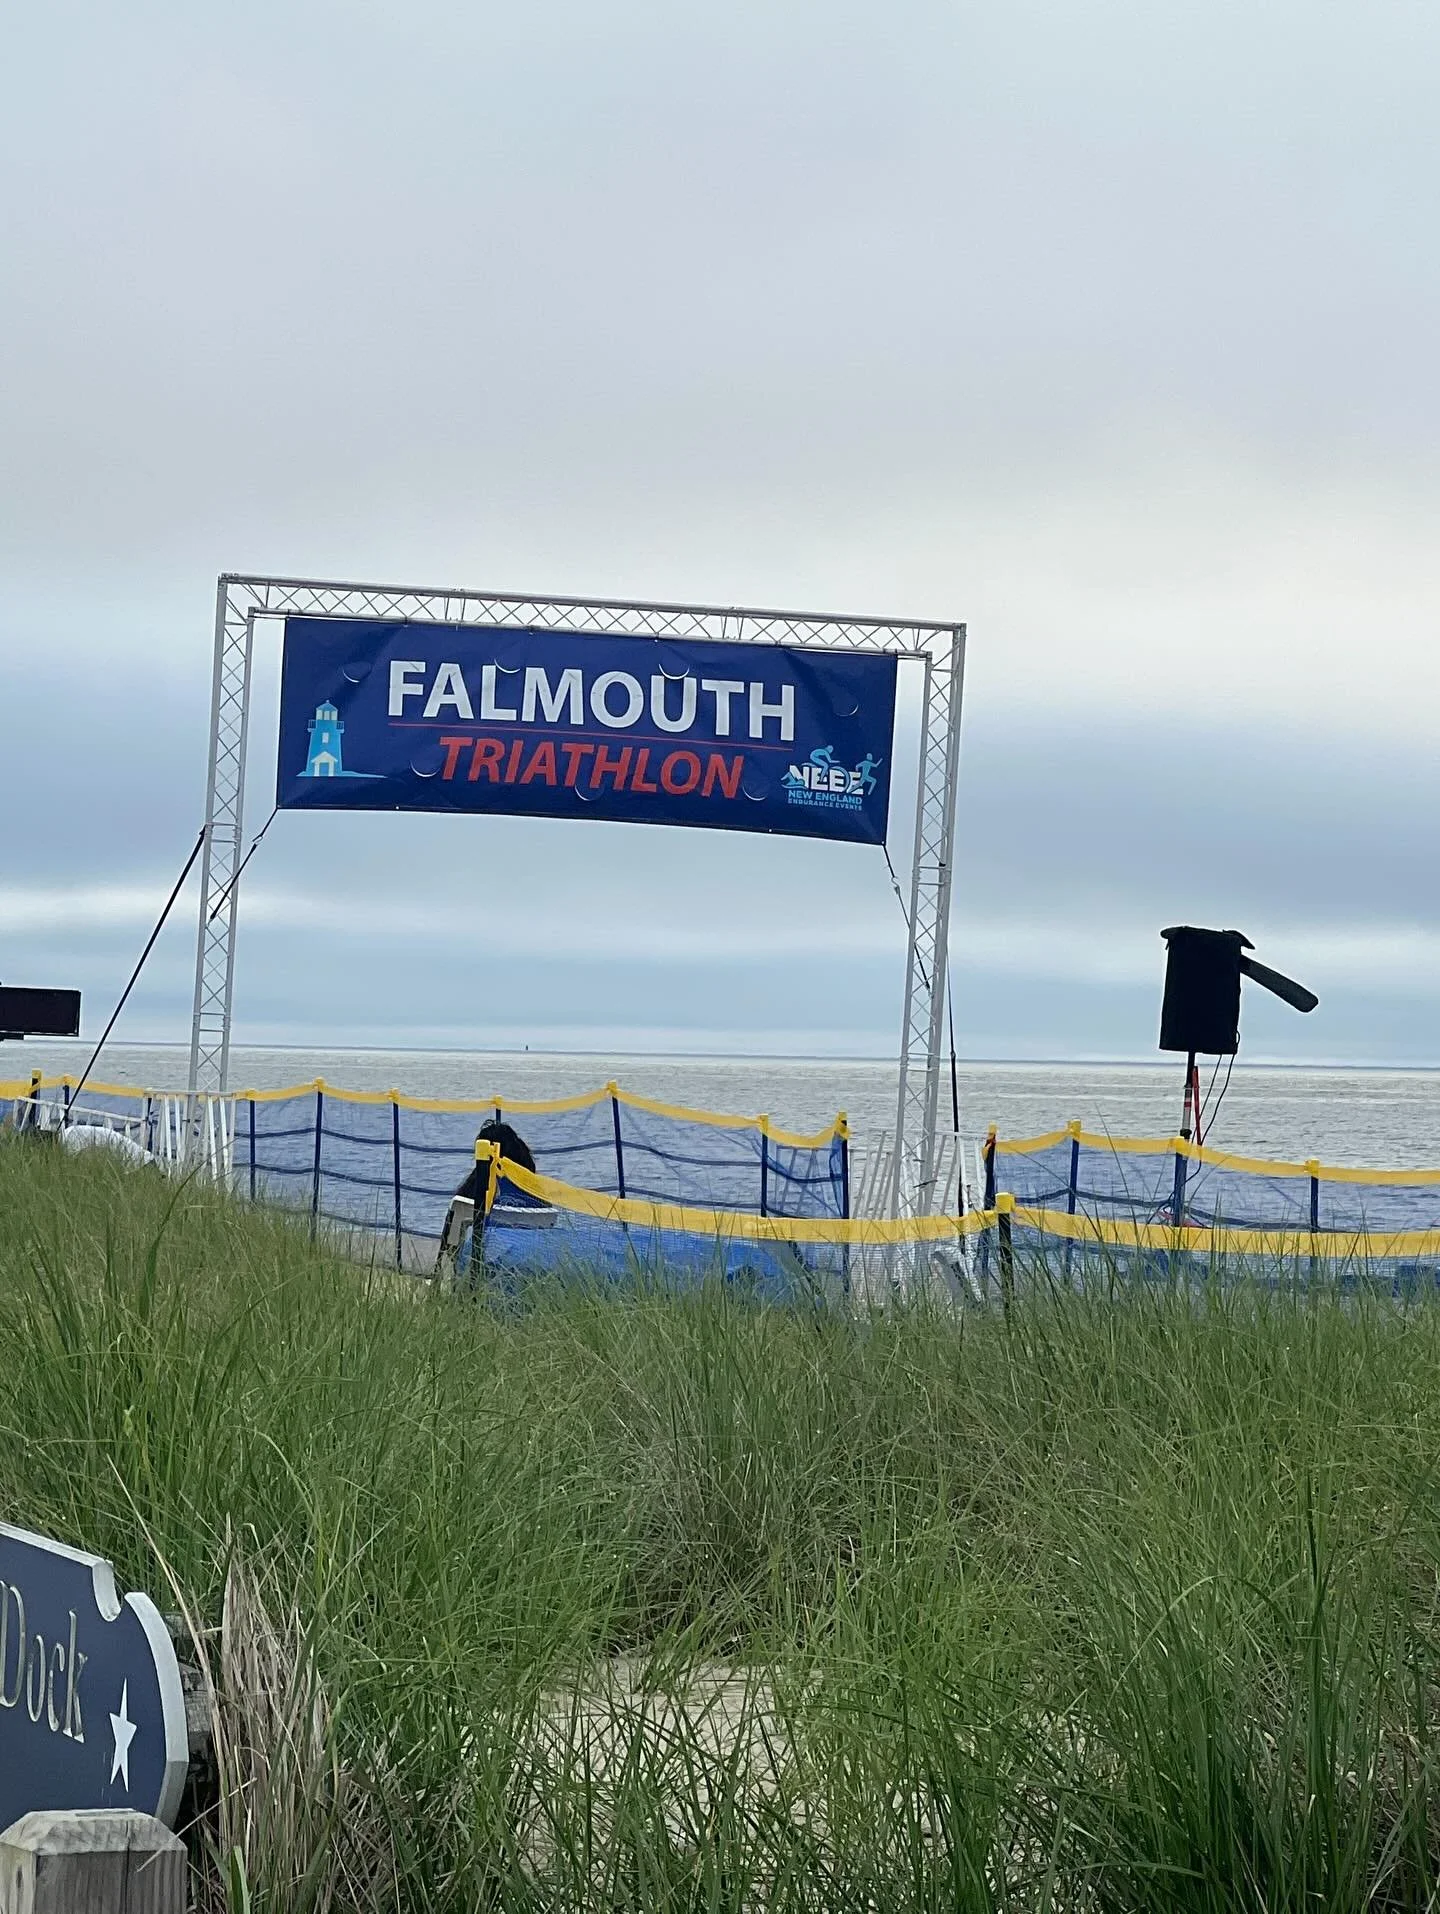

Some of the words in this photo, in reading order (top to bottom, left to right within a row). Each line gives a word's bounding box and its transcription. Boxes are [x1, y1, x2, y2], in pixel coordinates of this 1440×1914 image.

[387, 659, 796, 741] FALMOUTH
[438, 736, 745, 800] TRIATHLON
[788, 790, 813, 800] NEW
[815, 793, 863, 805] ENGLAND
[788, 798, 834, 808] ENDURANCE
[836, 803, 862, 811] EVENTS
